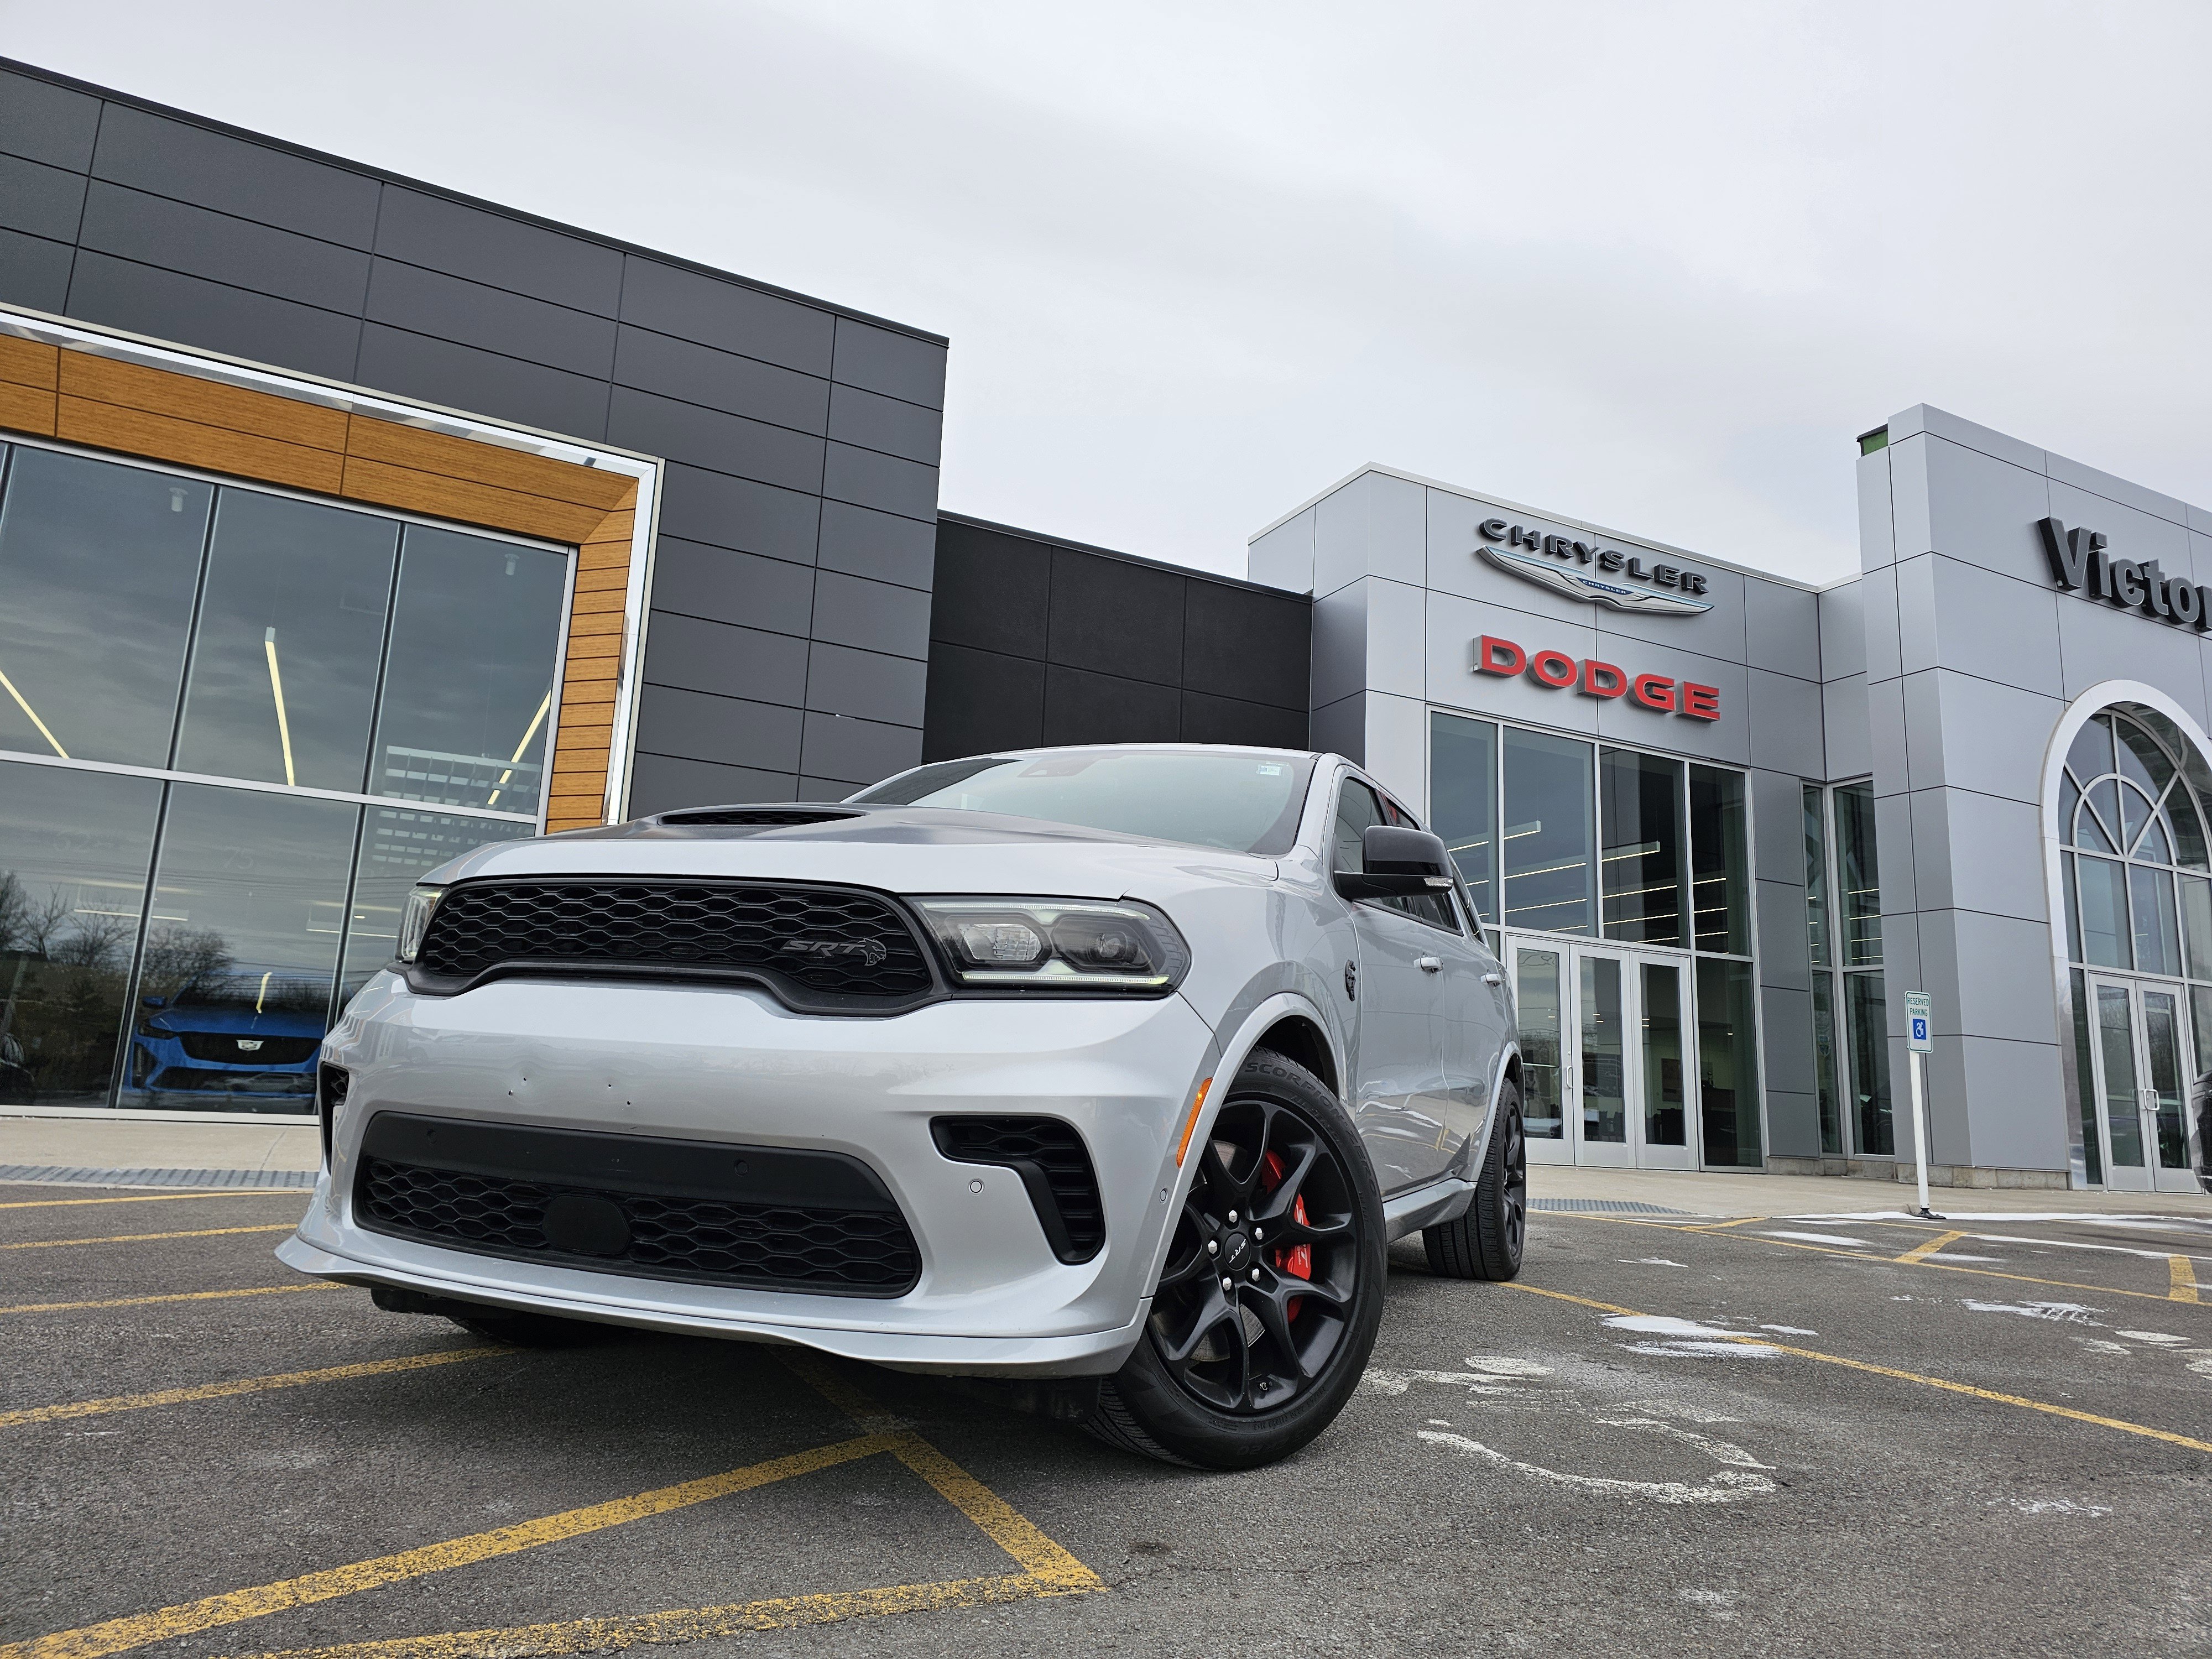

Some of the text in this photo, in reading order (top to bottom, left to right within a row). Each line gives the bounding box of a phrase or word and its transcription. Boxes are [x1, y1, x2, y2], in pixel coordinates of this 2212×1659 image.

[1479, 518, 1709, 593] CHRYSLER
[1473, 634, 1720, 722] DODGE
[782, 940, 867, 957] SRT
[1907, 998, 1929, 1006] RESERVED
[1910, 1008, 1928, 1016] PARKING
[1245, 1062, 1345, 1120] SCORPION
[1229, 1239, 1246, 1264] SRT
